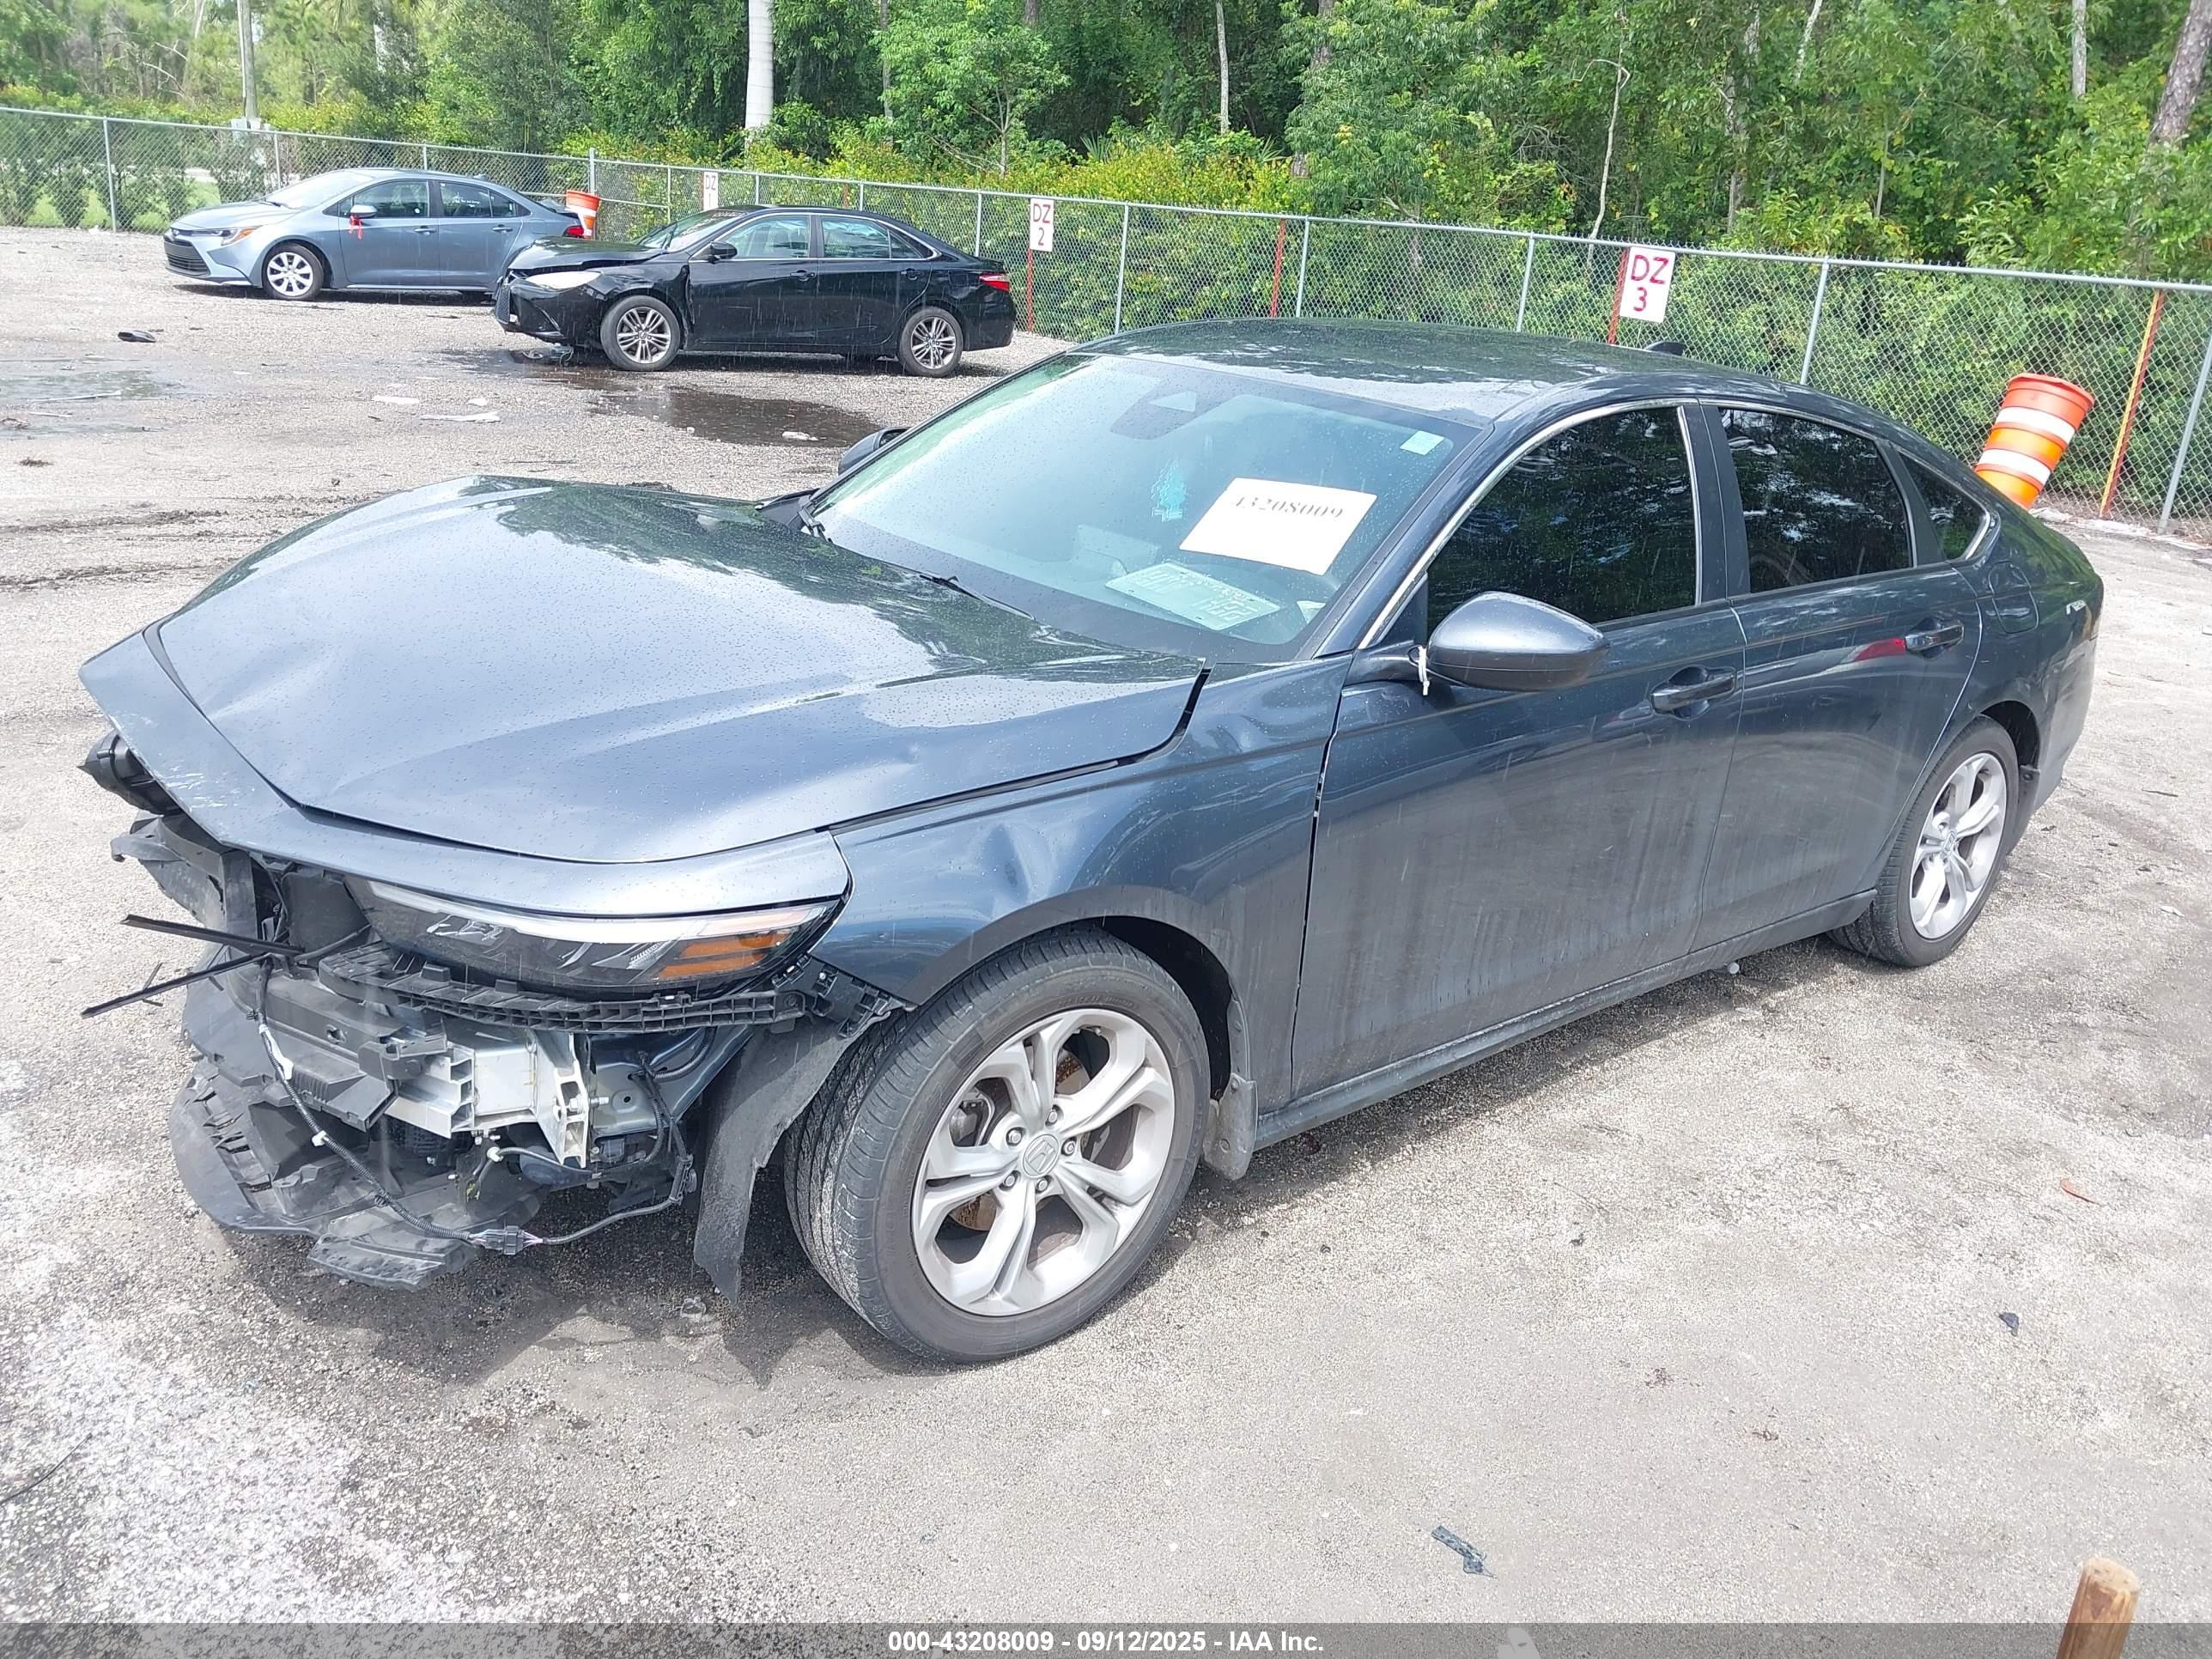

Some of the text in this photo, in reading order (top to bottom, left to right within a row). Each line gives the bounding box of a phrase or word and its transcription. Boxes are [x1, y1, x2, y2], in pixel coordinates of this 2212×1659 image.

[705, 174, 716, 191] DZ
[1033, 203, 1052, 223] DZ
[1037, 227, 1045, 246] 2
[1631, 254, 1669, 285] DZ
[1633, 287, 1648, 312] 3
